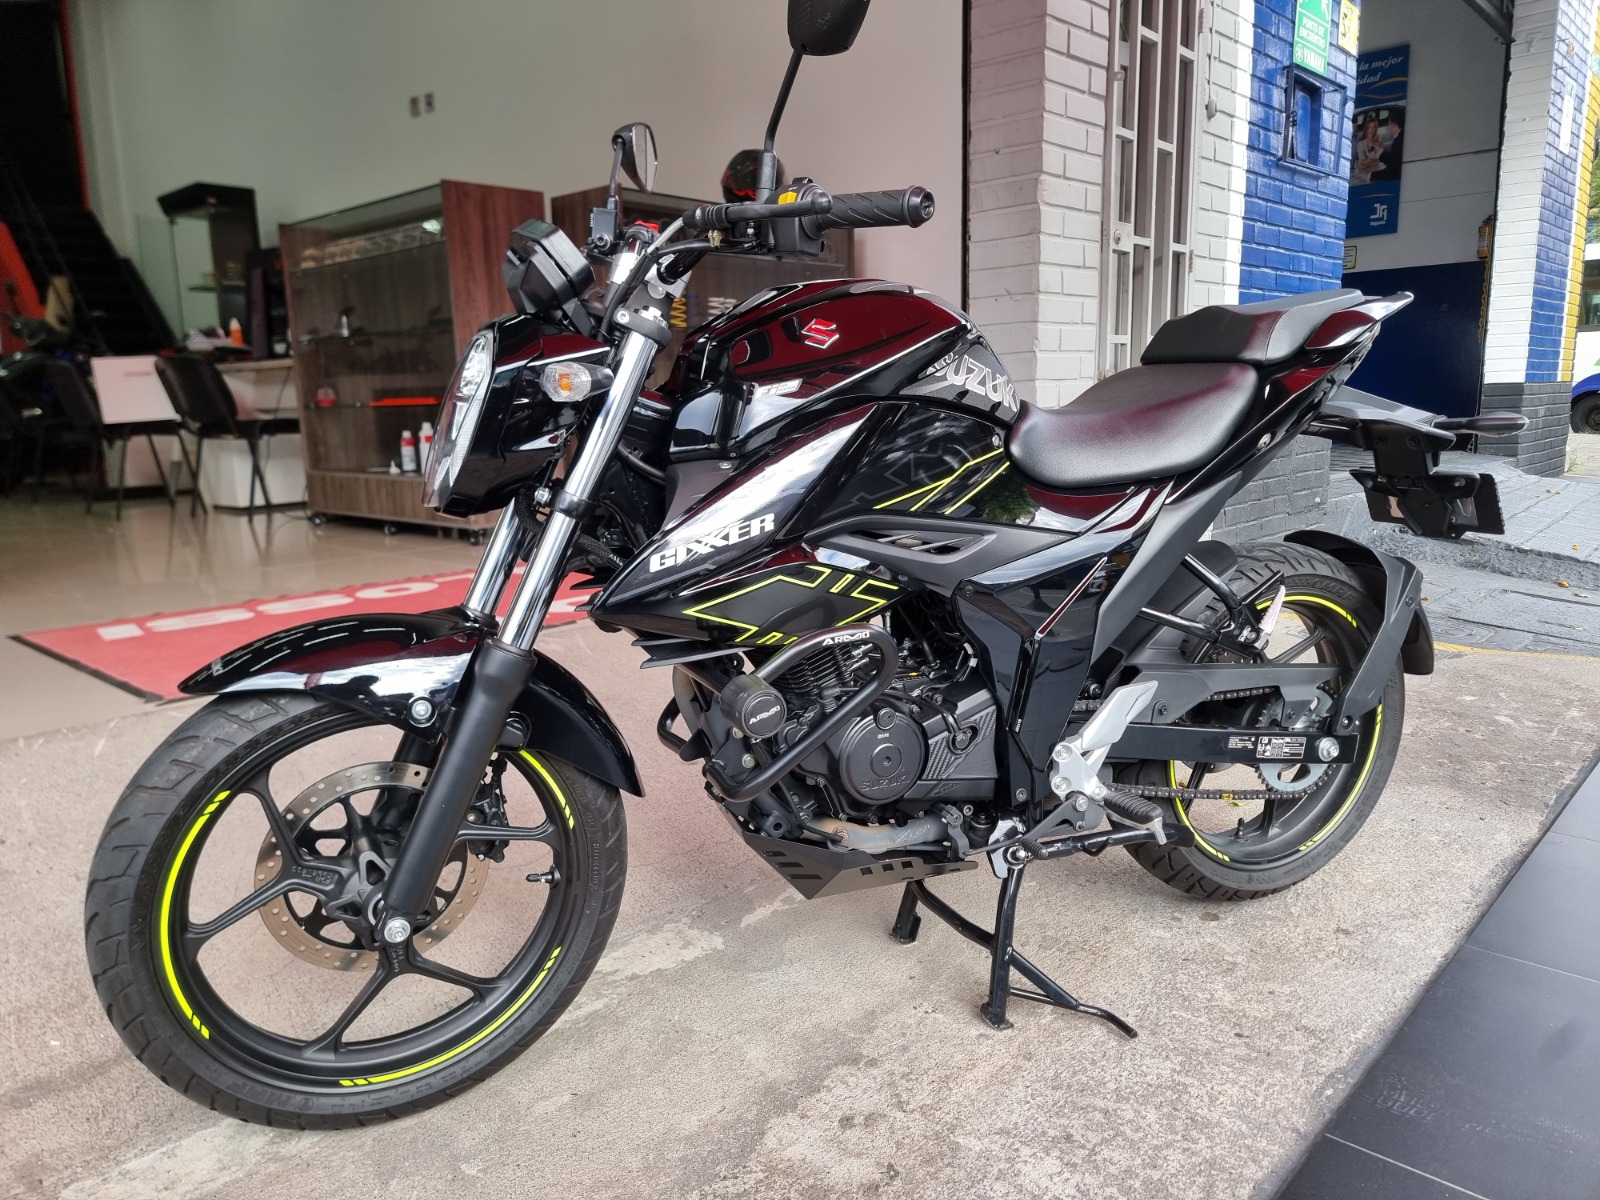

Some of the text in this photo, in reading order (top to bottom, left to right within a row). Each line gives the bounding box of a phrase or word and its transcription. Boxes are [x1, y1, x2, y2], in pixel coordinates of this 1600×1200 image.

[1358, 55, 1404, 71] la mejor
[649, 512, 775, 573] GIXXER
